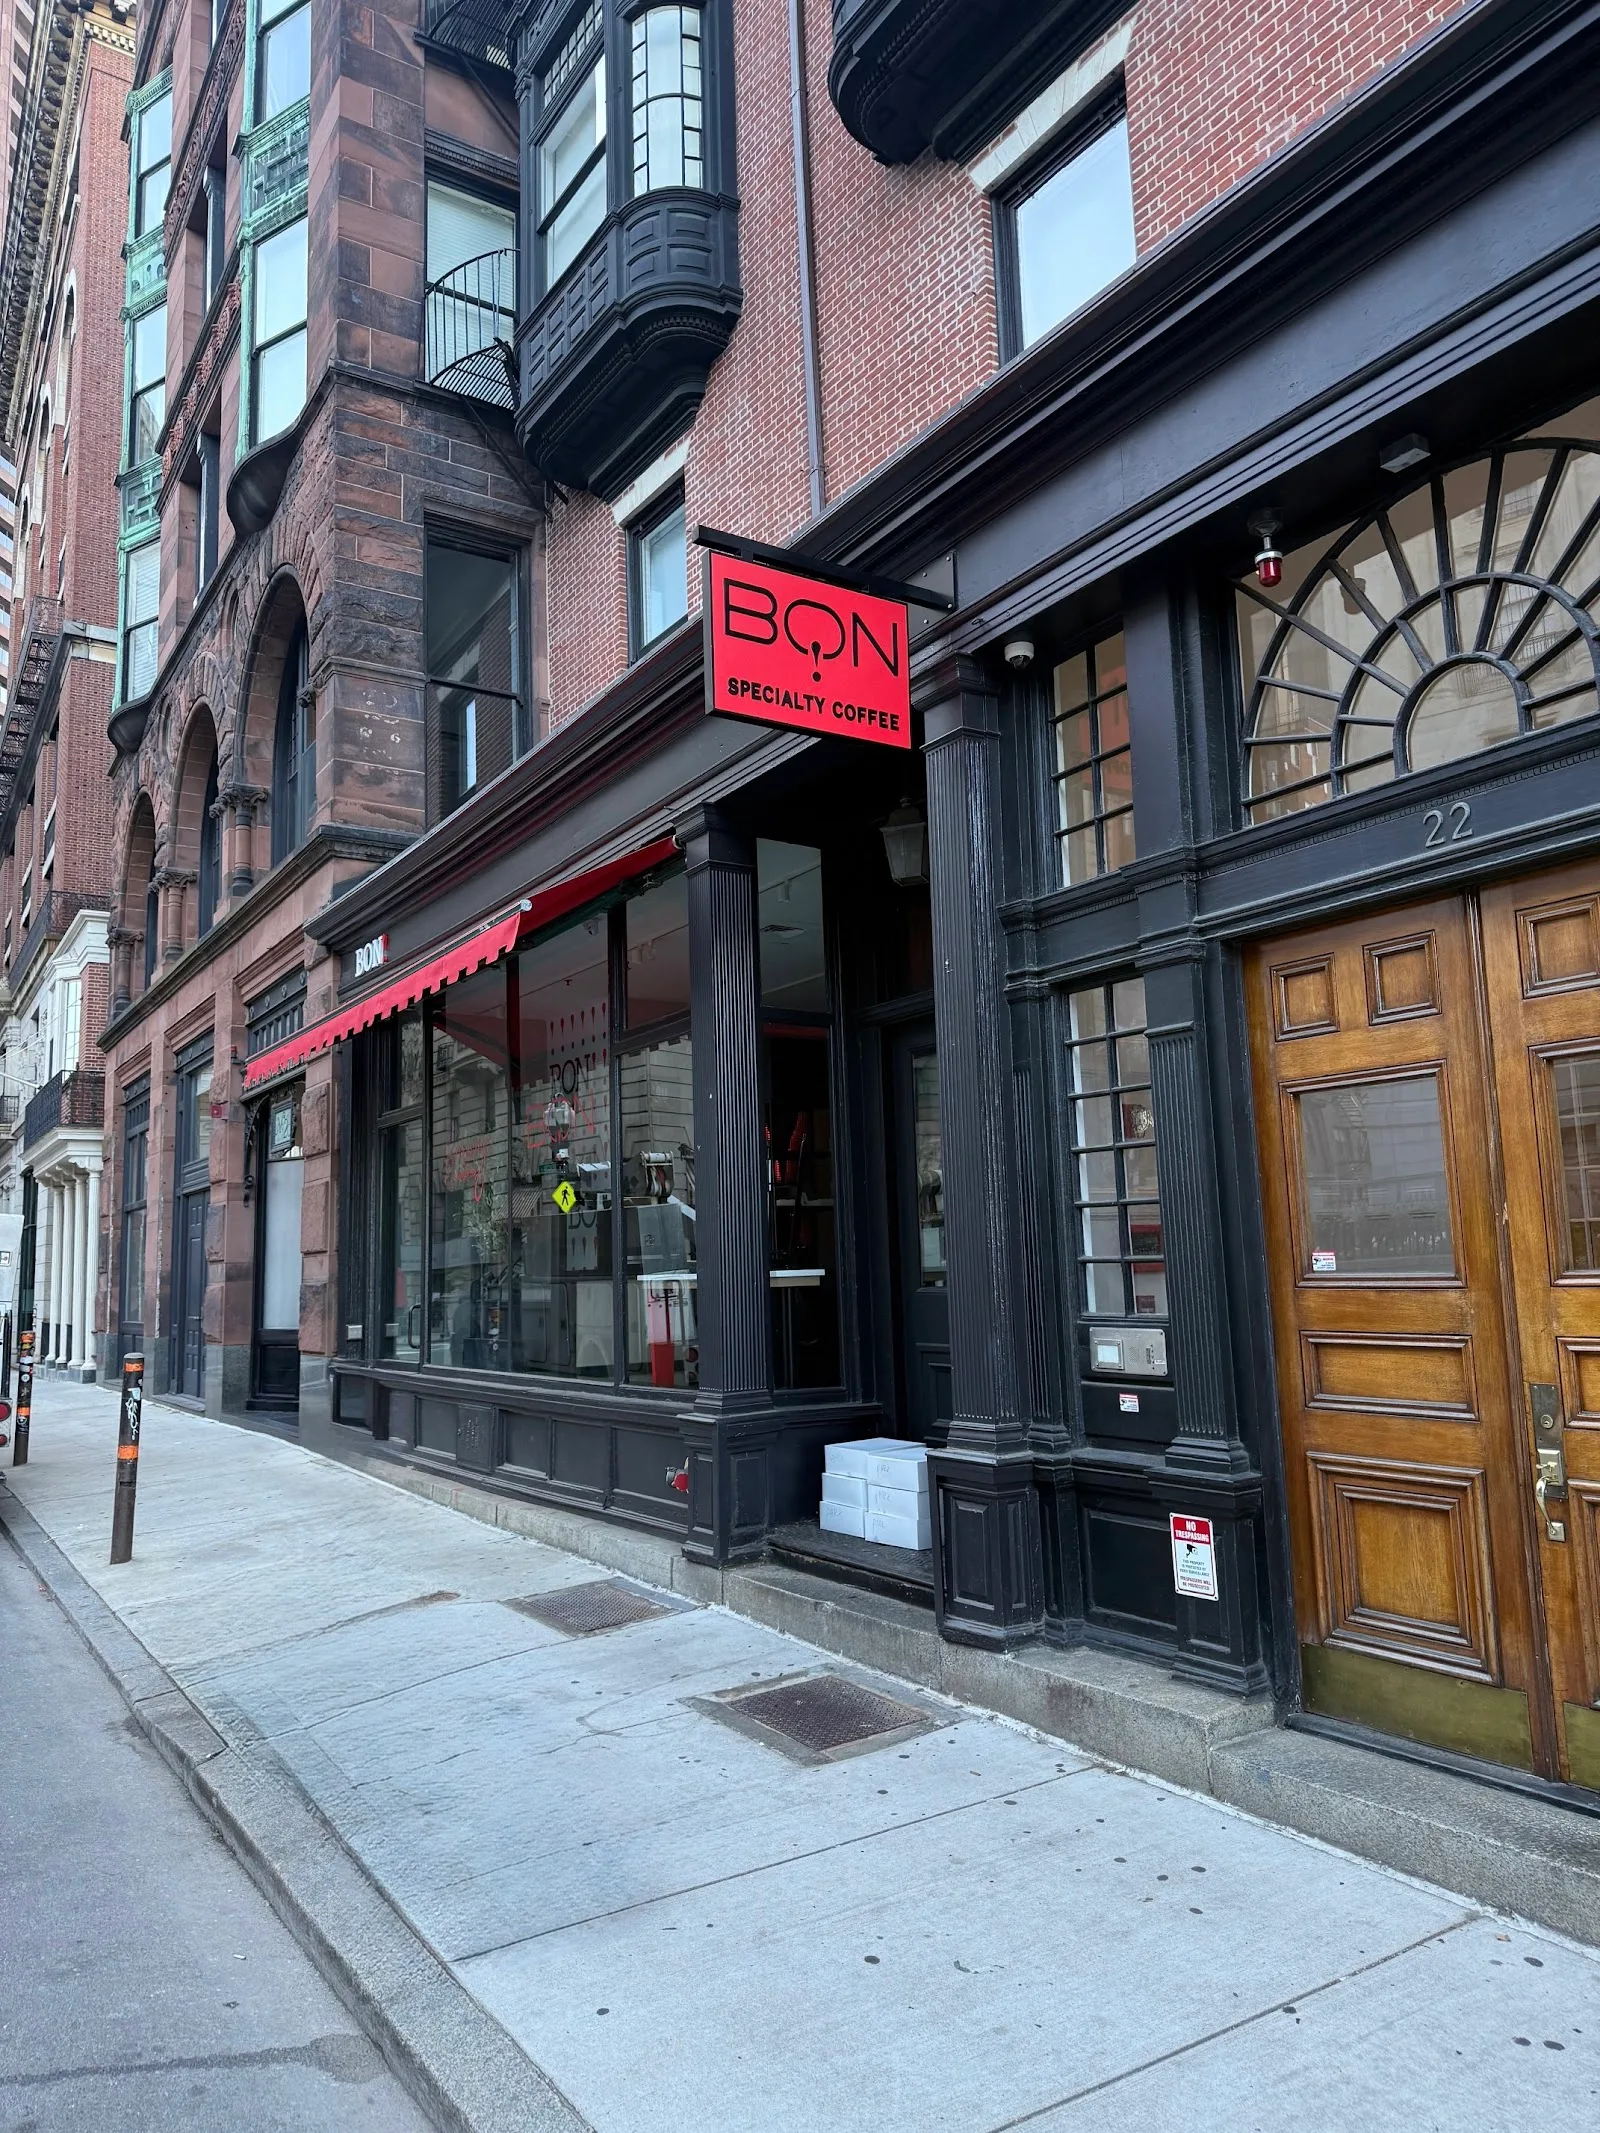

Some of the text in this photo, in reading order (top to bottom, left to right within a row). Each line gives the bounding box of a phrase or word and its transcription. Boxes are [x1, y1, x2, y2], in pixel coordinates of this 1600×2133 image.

[727, 677, 900, 731] SPECIALTY COFFEE
[1422, 801, 1473, 848] 22
[1175, 1529, 1210, 1543] TRESPASSING
[1185, 1520, 1197, 1532] NO
